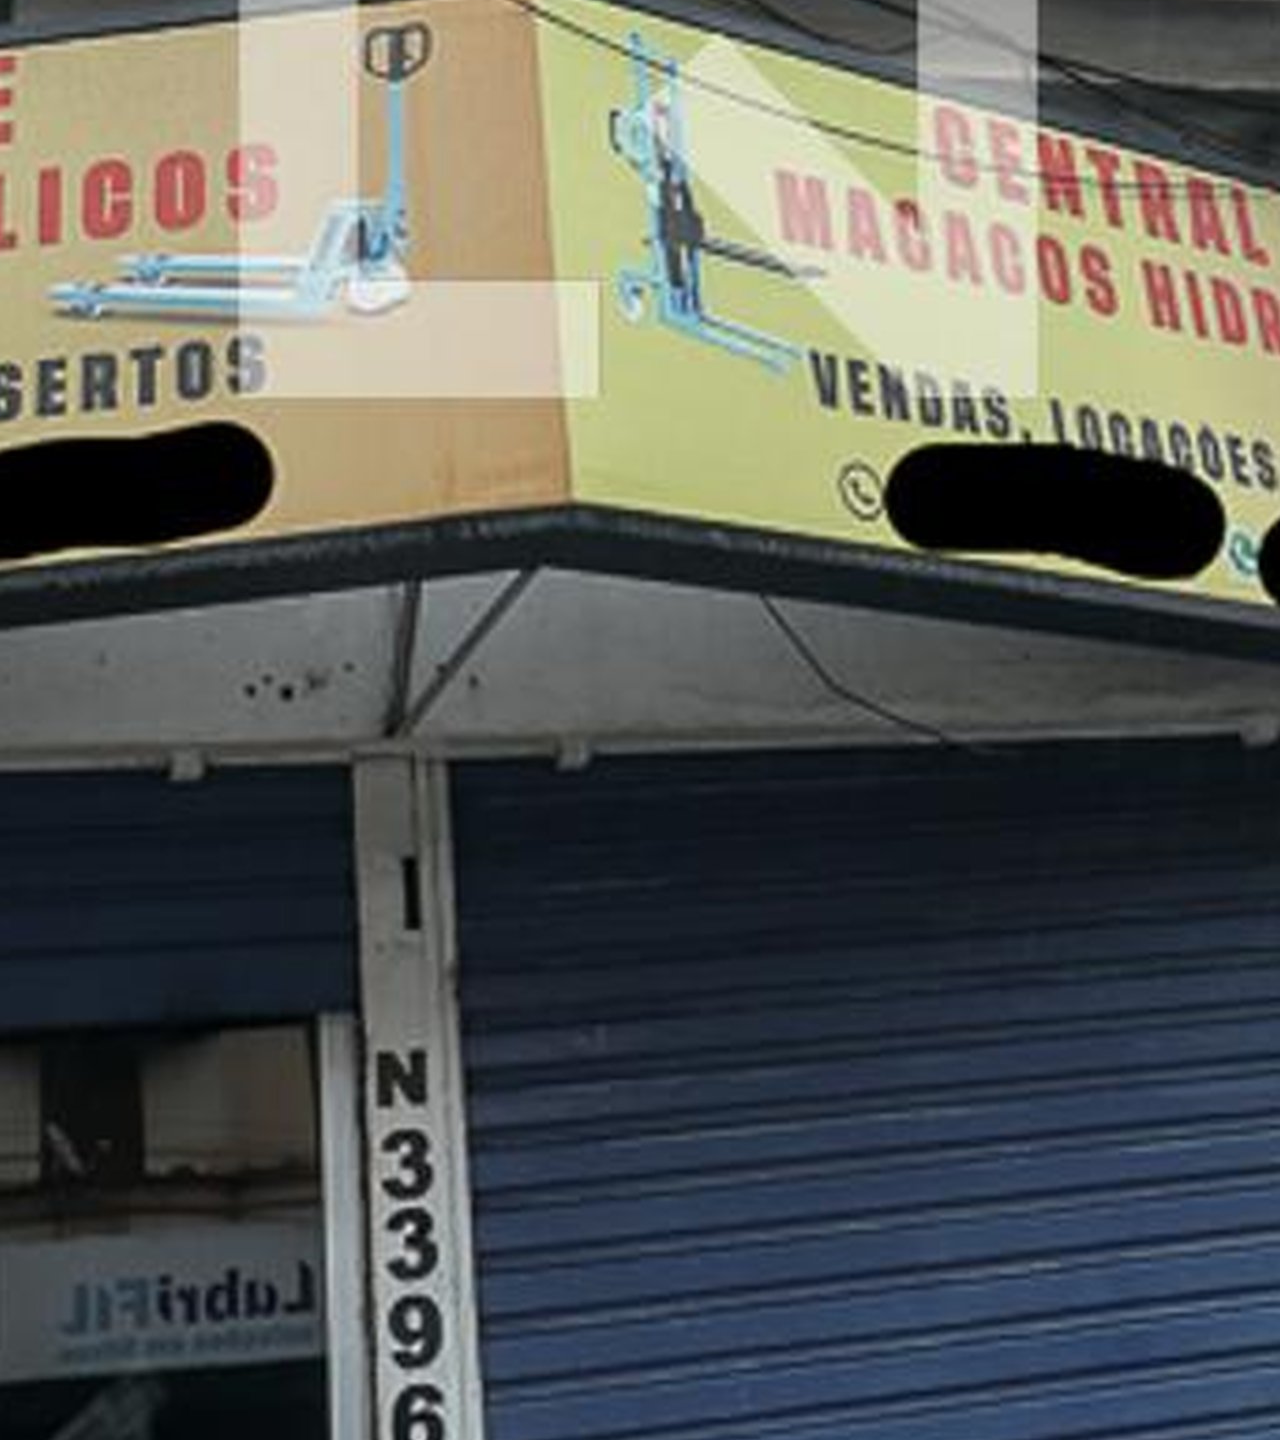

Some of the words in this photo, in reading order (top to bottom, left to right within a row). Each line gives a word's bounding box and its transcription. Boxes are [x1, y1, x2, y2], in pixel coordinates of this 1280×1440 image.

[773, 169, 1119, 315] MACACOS
[932, 104, 1268, 267] CENTRAL
[809, 349, 1033, 443] VENDAS,
